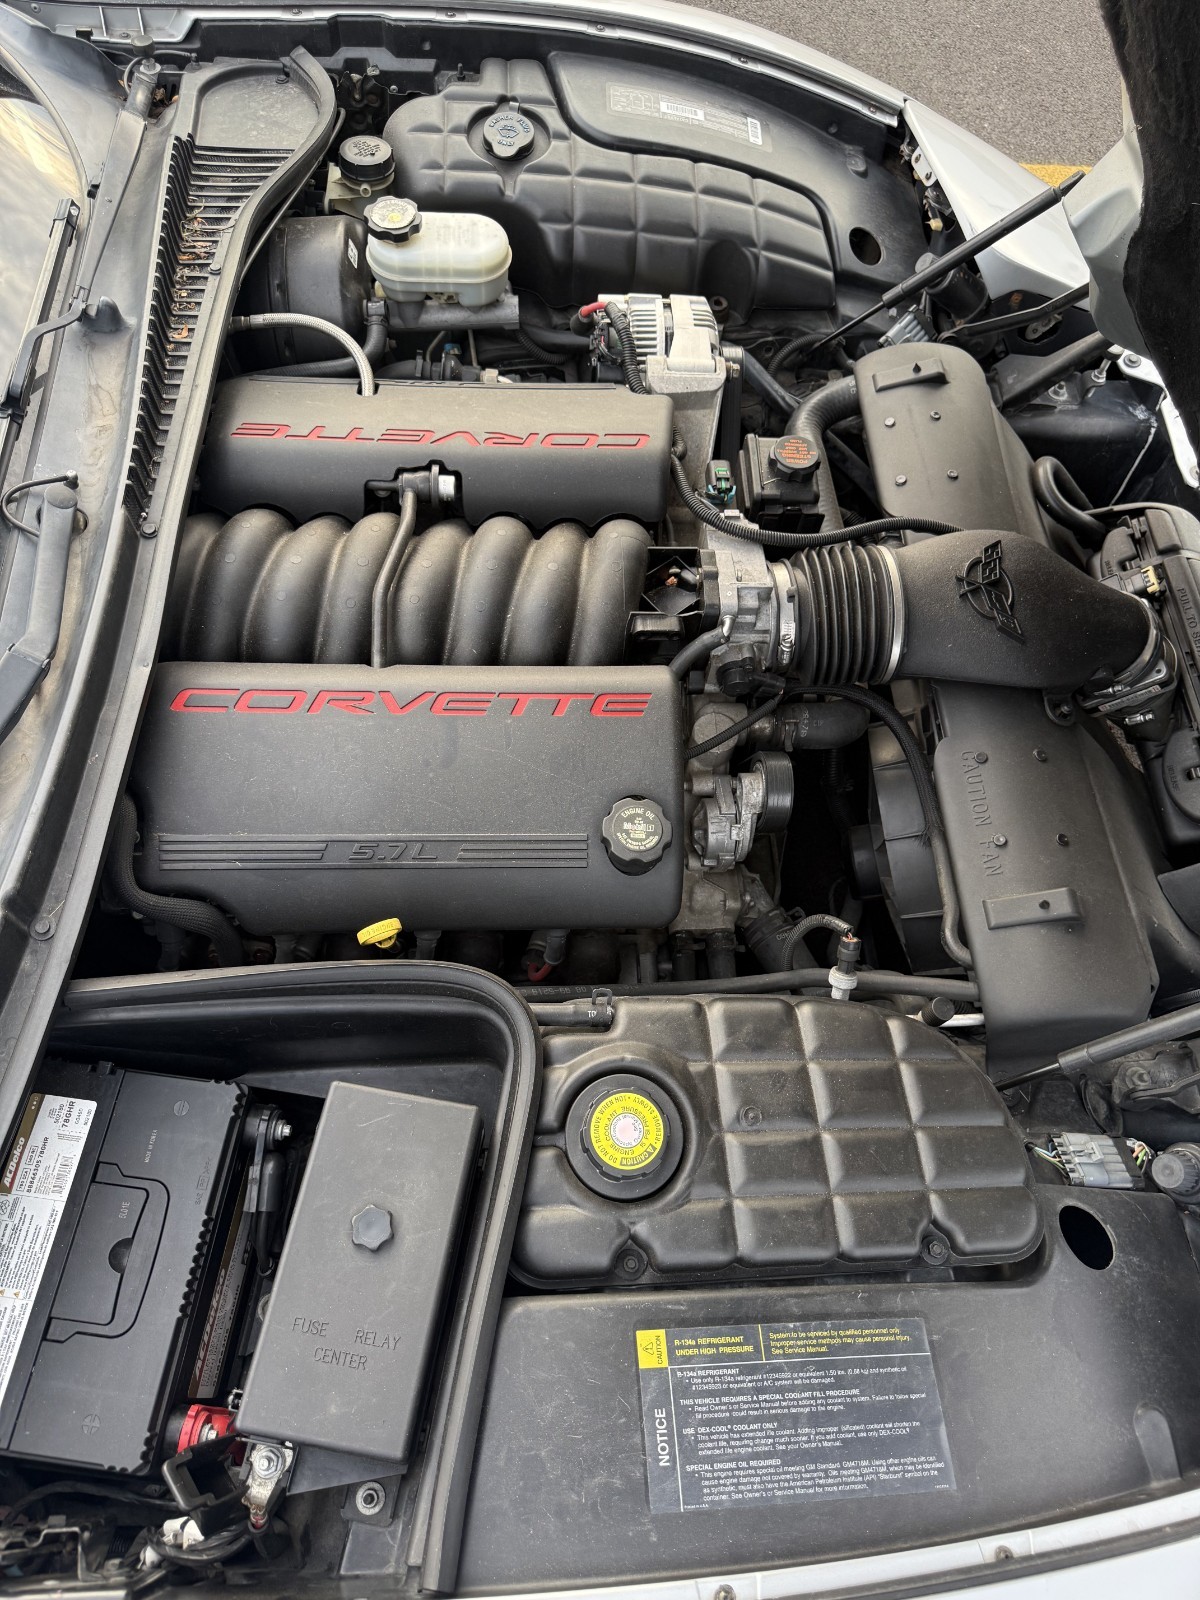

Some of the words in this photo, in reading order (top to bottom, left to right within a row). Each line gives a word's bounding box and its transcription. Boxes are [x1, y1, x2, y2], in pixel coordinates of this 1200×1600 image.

[232, 421, 650, 449] CORVETTE
[1177, 588, 1193, 614] PULL
[1186, 615, 1198, 629] TO
[169, 688, 652, 718] CORVETTE
[621, 808, 644, 817] ENGINE
[646, 811, 655, 820] OIL
[959, 750, 991, 827] CAUTION
[980, 841, 1004, 877] FAN
[348, 841, 441, 862] 5.7L
[61, 1100, 76, 1128] 78GHR
[1, 1136, 26, 1186] ACDelco
[25, 1159, 41, 1193] 88866305
[37, 1136, 49, 1158] 78GHR
[191, 1268, 228, 1381] ACDelco
[292, 1316, 328, 1338] FUSE
[355, 1328, 402, 1350] RELAY
[655, 1335, 663, 1364] CAUTION
[675, 1348, 698, 1356] UNDER
[718, 1345, 754, 1353] PRESSURE
[697, 1336, 744, 1344] REFRIGERANT
[313, 1346, 368, 1371] CENTER
[697, 1368, 739, 1376] REFRIGERANT
[784, 1391, 813, 1399] COOLANT
[654, 1407, 670, 1467] NOTICE
[732, 1423, 761, 1431] COOLANT
[686, 1463, 712, 1471] SPECIAL
